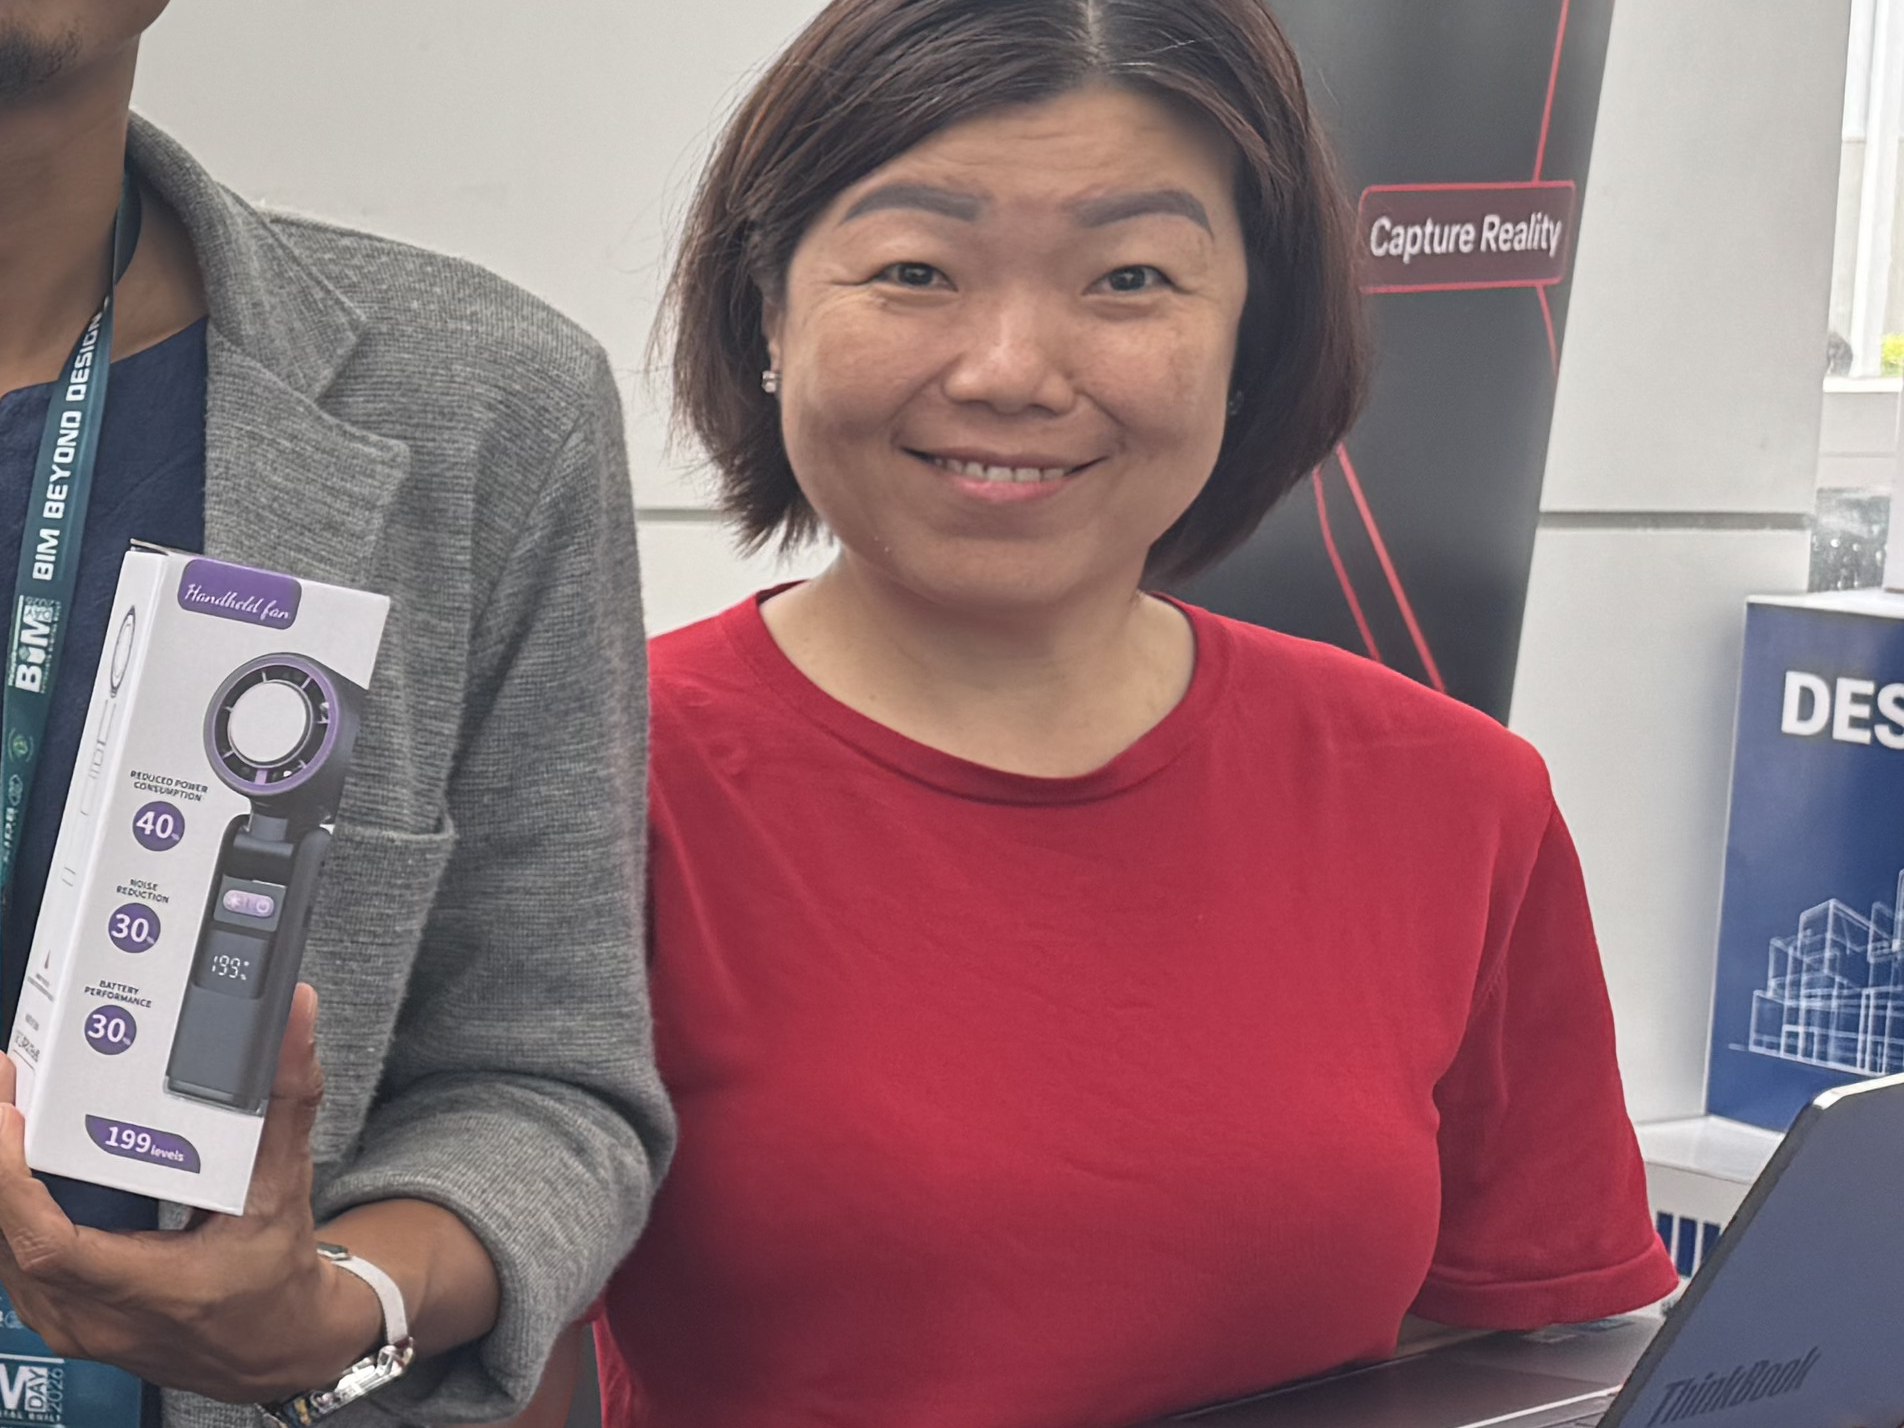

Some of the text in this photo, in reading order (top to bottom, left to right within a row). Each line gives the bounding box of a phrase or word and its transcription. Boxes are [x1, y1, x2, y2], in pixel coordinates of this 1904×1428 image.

[1370, 212, 1562, 263] Capture Reality
[32, 310, 103, 581] BIM BEYOND DESIGN
[184, 583, 289, 621] Handheld fan
[1781, 670, 1904, 750] DES
[130, 770, 209, 794] REDUCED POWER
[133, 781, 202, 802] CONSUMPTION
[116, 885, 169, 904] REDUCTION
[130, 878, 159, 892] NOISE
[84, 986, 152, 1008] PERFORMANCE
[99, 979, 140, 996] BATTERY
[105, 1125, 184, 1162] 199 levels
[1646, 1345, 1821, 1428] ThinkBook
